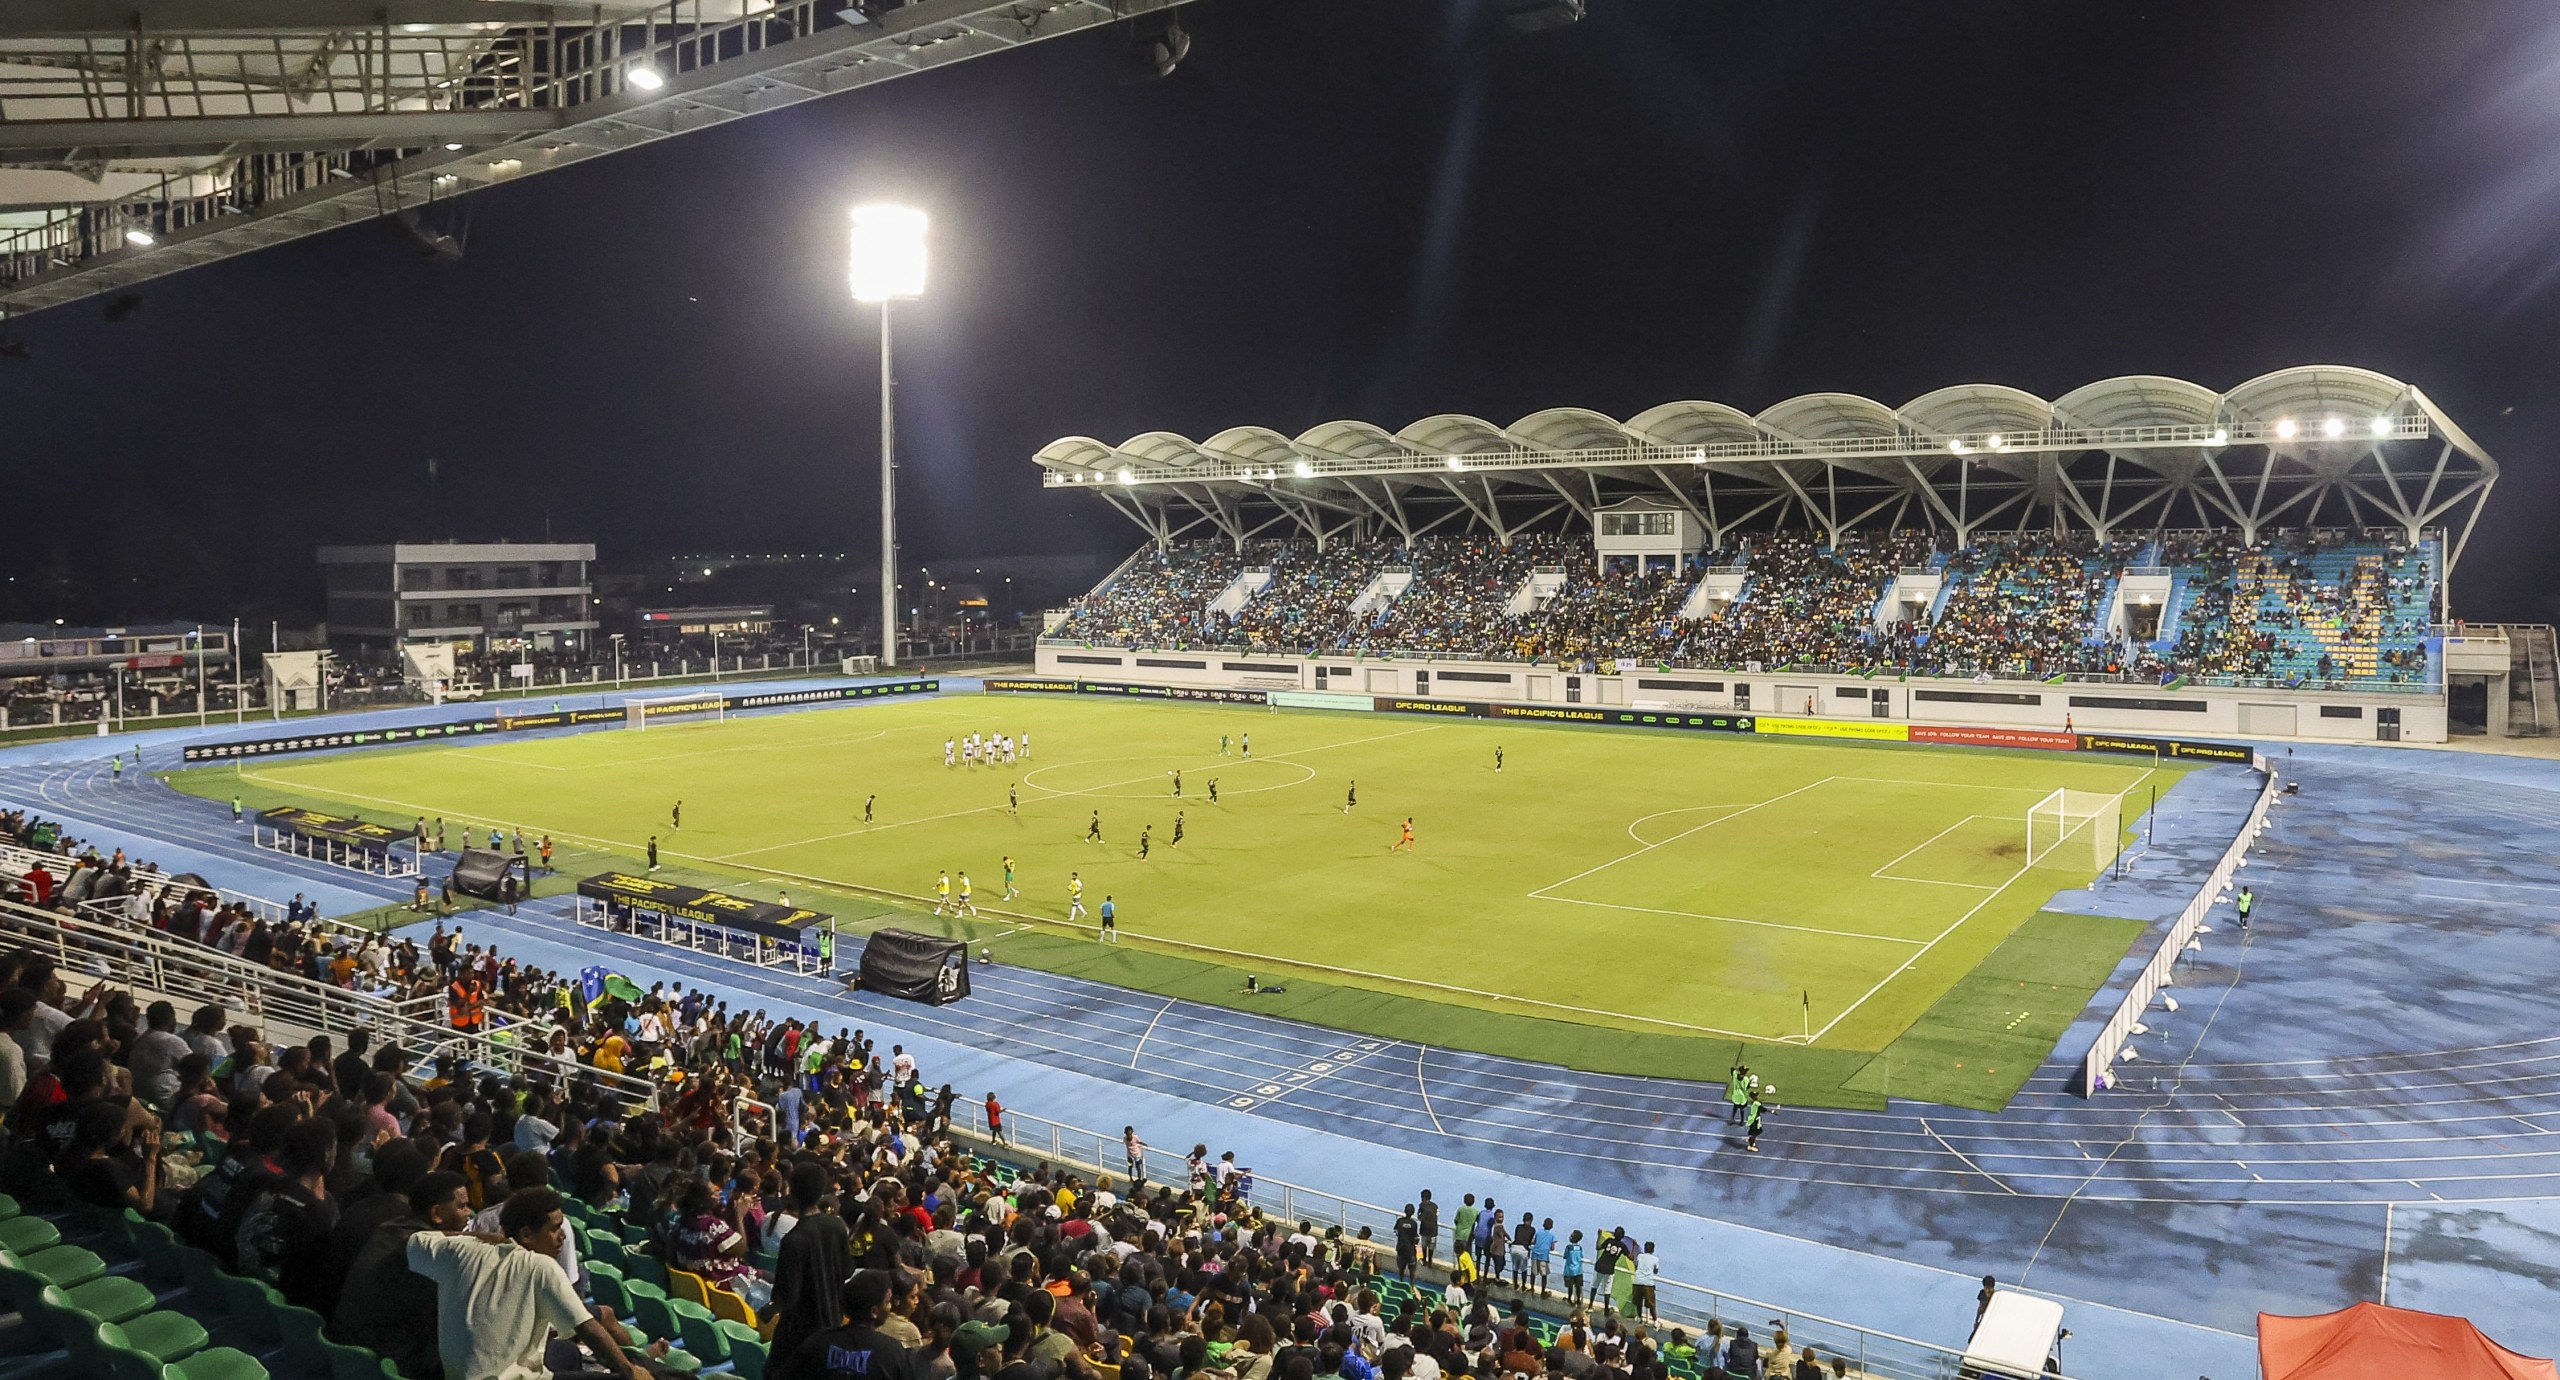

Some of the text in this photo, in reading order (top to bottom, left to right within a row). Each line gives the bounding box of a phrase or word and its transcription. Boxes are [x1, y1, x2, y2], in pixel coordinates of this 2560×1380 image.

[1432, 704, 1466, 712] LEAGUE
[1520, 709, 1565, 718] PACIFIC'S
[1566, 711, 1604, 720] LEAGUE
[2127, 743, 2157, 751] LEAGUE
[2213, 750, 2245, 758] LEAGUE
[613, 893, 715, 923] THE PACIFIC'S LEAGUE
[1358, 1042, 1380, 1050] 4
[1333, 1051, 1357, 1061] 5
[1309, 1062, 1333, 1072] 6
[1285, 1073, 1309, 1082] 7
[1256, 1085, 1281, 1095] 8
[1229, 1097, 1254, 1107] 9
